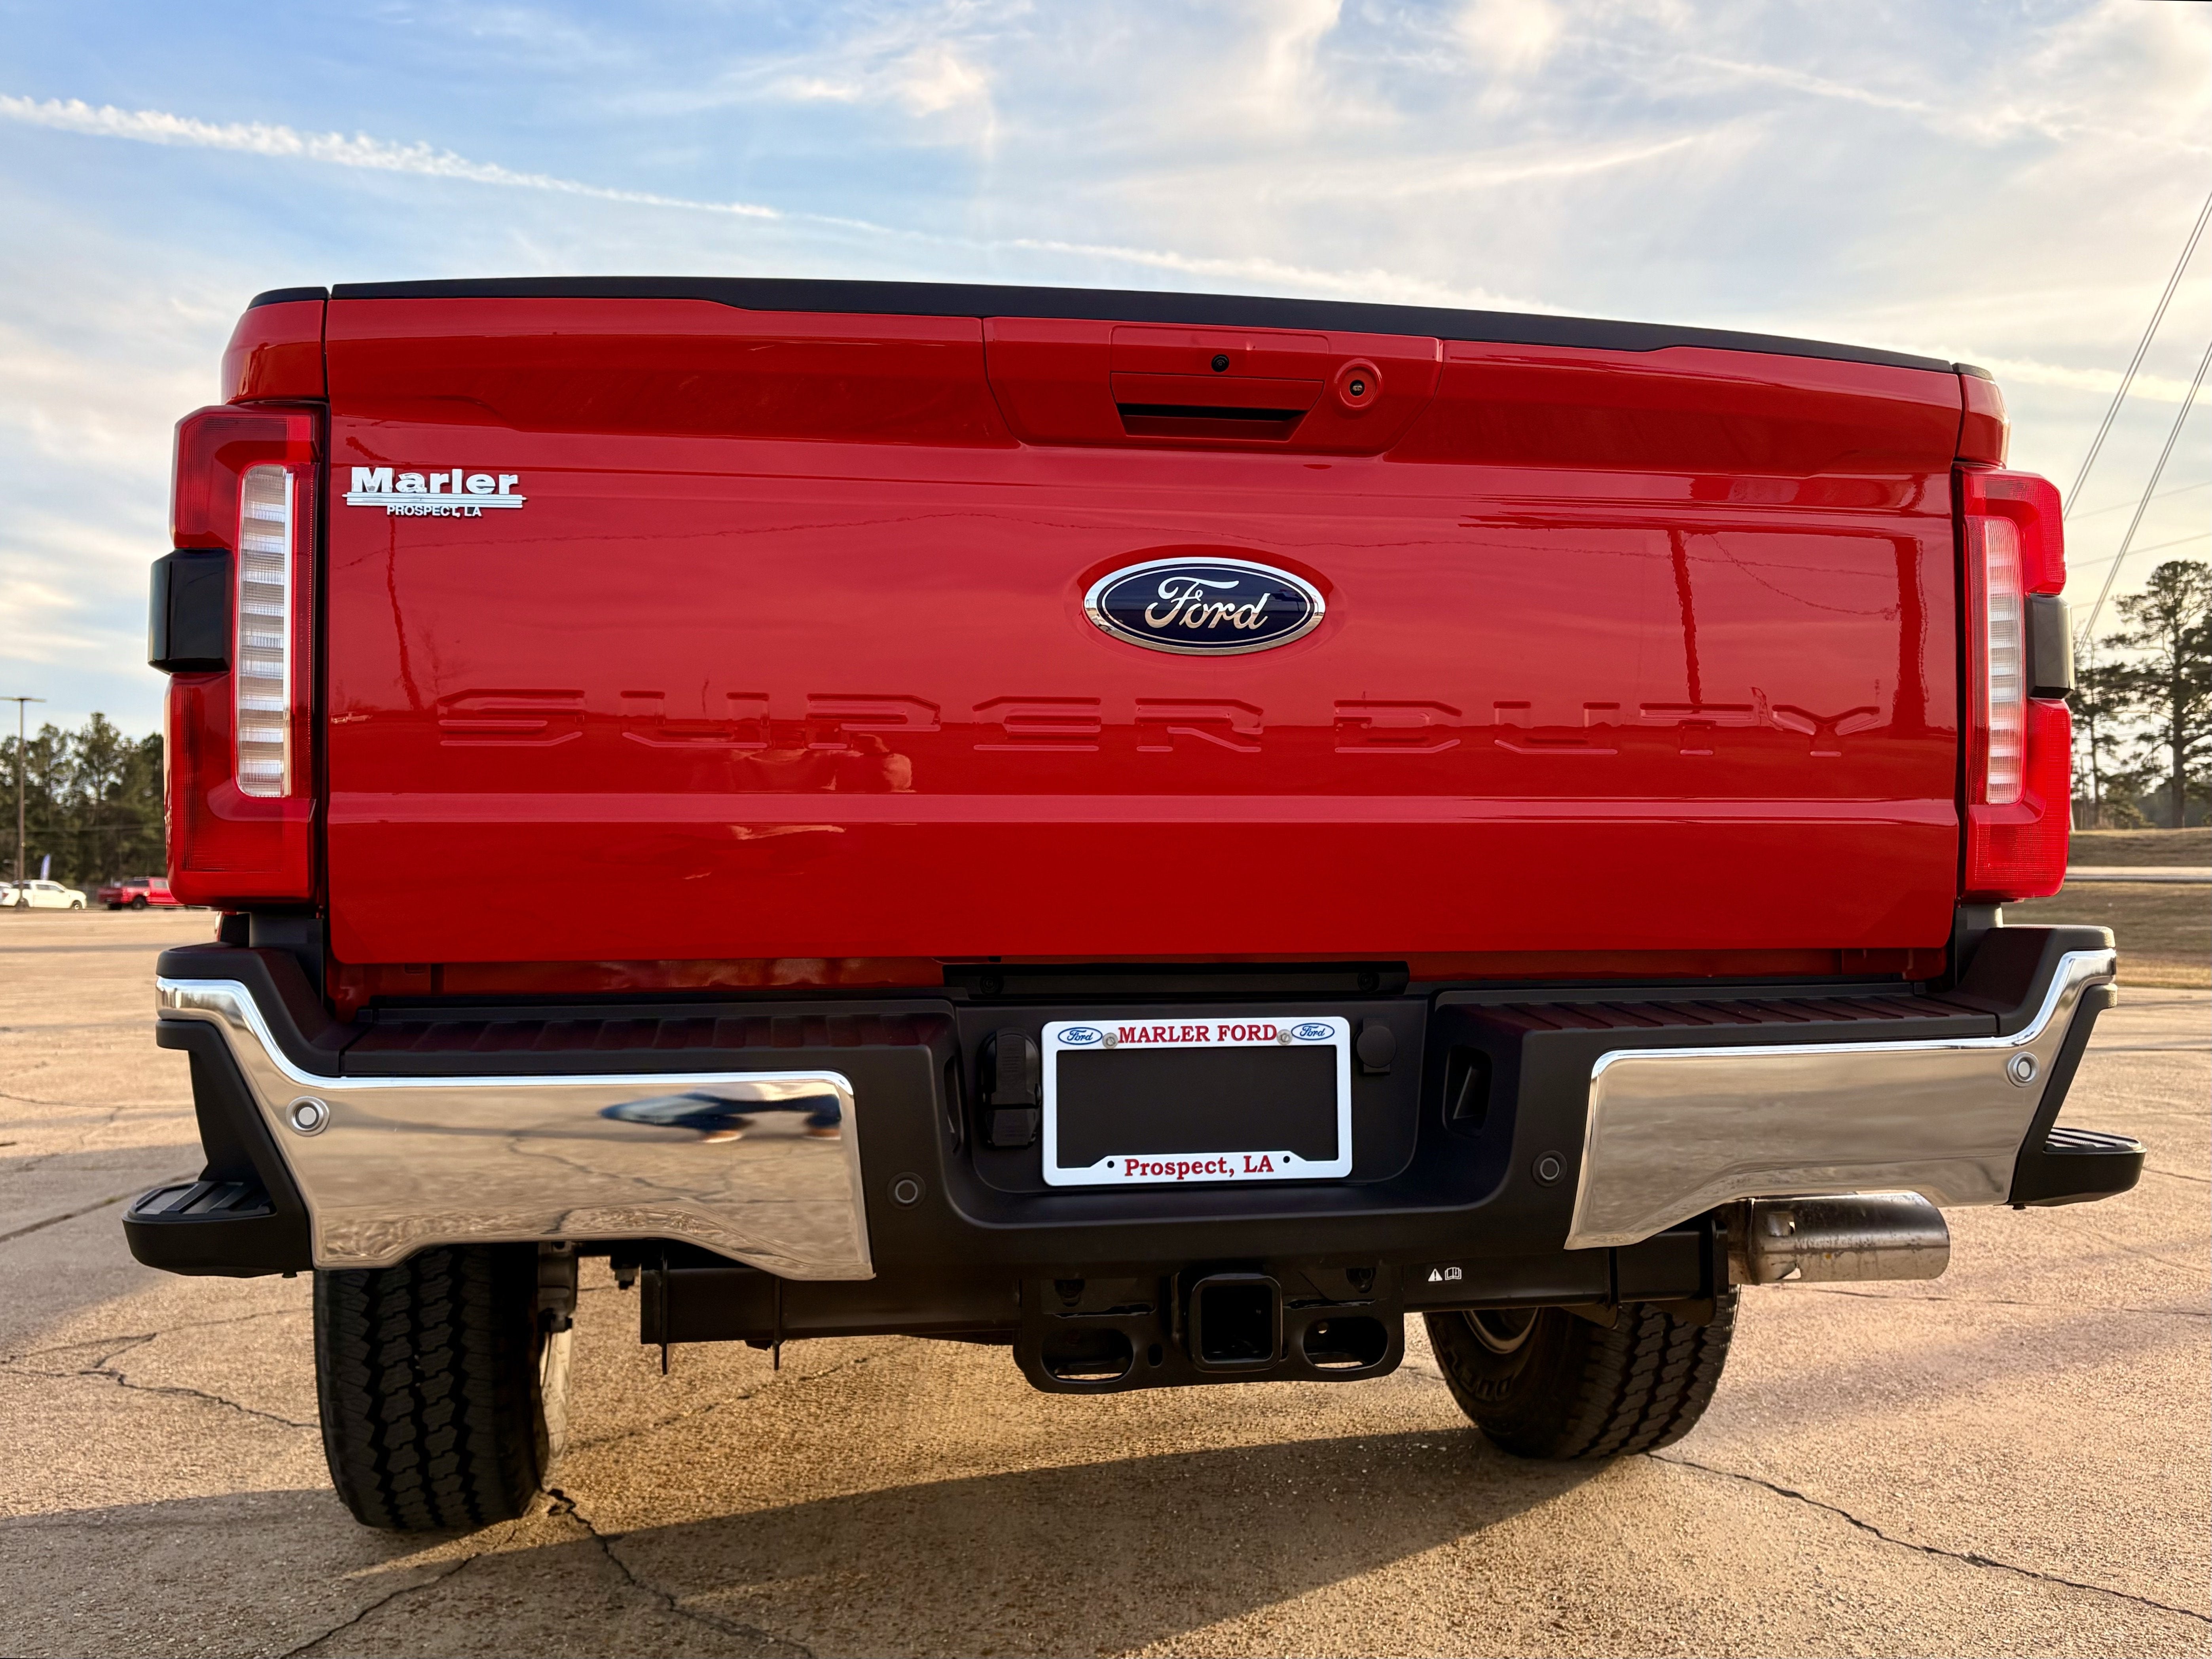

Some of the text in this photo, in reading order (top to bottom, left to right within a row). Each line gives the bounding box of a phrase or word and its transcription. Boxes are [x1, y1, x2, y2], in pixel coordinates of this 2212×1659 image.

[351, 467, 518, 495] Marler
[387, 505, 482, 518] PROSPECT, LA
[1145, 576, 1268, 629] Ford
[437, 688, 1881, 757] SUPER DUTY
[1067, 1029, 1094, 1041] Ford
[1118, 1025, 1277, 1043] MARLER FORD
[1299, 1025, 1325, 1037] Ford
[1124, 1155, 1274, 1180] Prospect, LA
